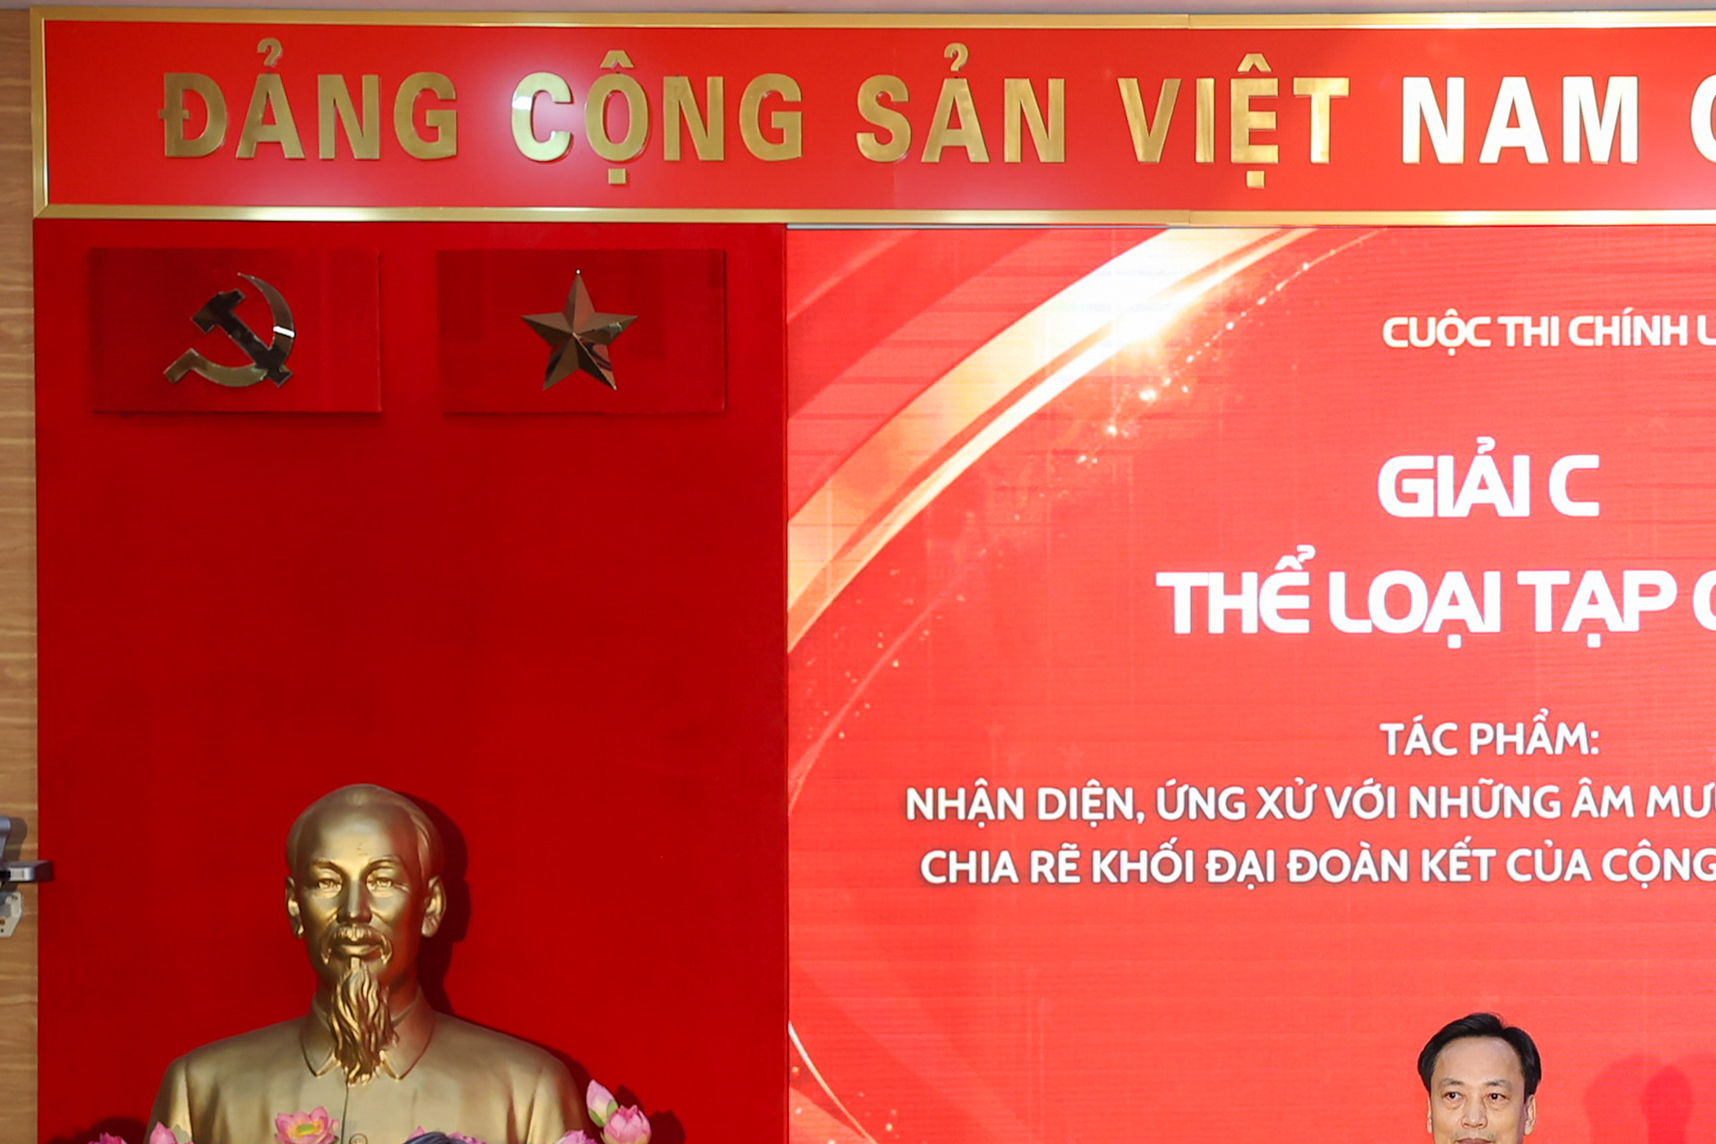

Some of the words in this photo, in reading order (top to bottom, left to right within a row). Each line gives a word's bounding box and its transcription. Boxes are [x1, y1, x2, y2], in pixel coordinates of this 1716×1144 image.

[157, 38, 459, 161] ĐẢNG
[509, 49, 803, 185] CỘNG
[856, 42, 1066, 164] SẢN
[1117, 53, 1351, 190] VIỆT
[1401, 75, 1640, 165] NAM
[1382, 308, 1492, 356] CUỘC
[1497, 315, 1560, 347] THI
[1568, 306, 1689, 347] CHÍNH
[1377, 436, 1531, 518] GIẢI
[1548, 454, 1600, 517] C
[1155, 544, 1316, 634] THỂ
[1328, 569, 1502, 649] LOẠI
[1516, 569, 1679, 649] TẠP
[1379, 714, 1458, 756] TÁC
[1470, 707, 1600, 756] PHẨM:
[905, 777, 1024, 829] NHẬN
[1037, 778, 1145, 829] DIỆN,
[1156, 778, 1246, 821] ỨNG
[1256, 776, 1318, 820] XỬ
[1324, 777, 1396, 820] VỚI
[1409, 777, 1561, 819] NHỮNG
[1571, 776, 1635, 818] ÂM
[920, 850, 1019, 884] CHIA
[1030, 842, 1081, 883] RẼ
[1092, 836, 1194, 884] KHỐI
[1205, 849, 1275, 890] ĐẠI
[1286, 840, 1408, 883] ĐOÀN
[1421, 835, 1497, 882] KẾT
[1506, 839, 1592, 882] CỦA
